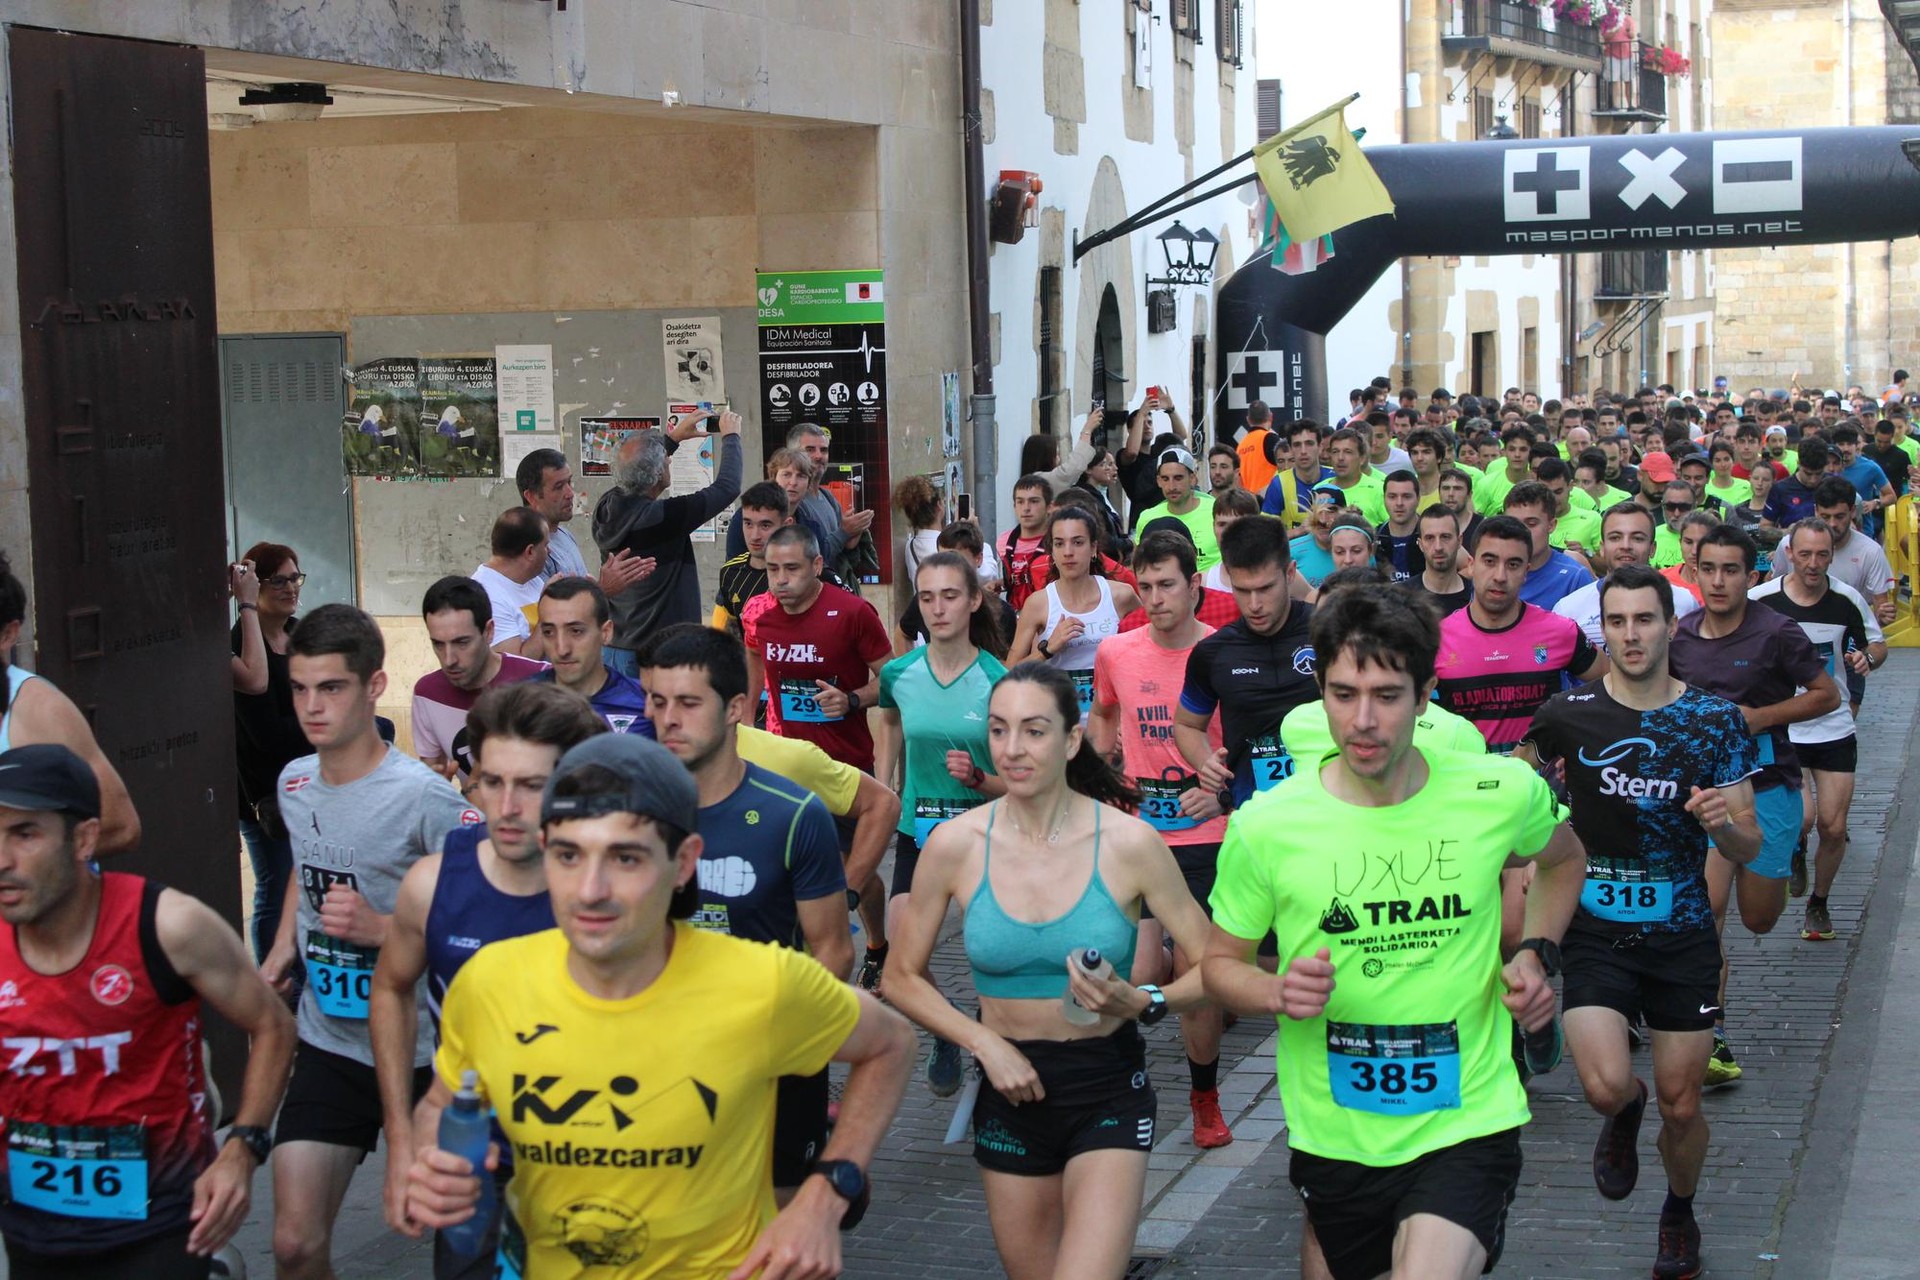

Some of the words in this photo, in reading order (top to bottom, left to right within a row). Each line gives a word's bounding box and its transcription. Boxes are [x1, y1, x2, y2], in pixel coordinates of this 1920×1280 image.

[1505, 219, 1804, 242] maspormenos.net
[758, 308, 785, 317] DESA
[665, 323, 702, 331] Osakidetza
[766, 330, 790, 340] IDM
[793, 328, 832, 339] Medical
[388, 365, 415, 373] EUSKAL
[766, 362, 834, 370] DESFIBRILADOREA
[766, 370, 820, 378] DESFIBRILADOR
[389, 381, 416, 389] AZOKA
[427, 373, 455, 381] LIBURU
[1291, 352, 1303, 421] os.net
[1137, 705, 1172, 721] XVIII.
[1598, 766, 1678, 800] Stern
[1334, 839, 1462, 898] UXUE
[1592, 866, 1614, 875] TRAIL
[1596, 883, 1657, 908] 318
[1362, 893, 1472, 926] TRAIL
[1340, 936, 1378, 947] MENDI
[1380, 927, 1461, 943] LASTERKETA
[1363, 940, 1438, 954] SOLIDARIOA
[318, 967, 371, 1001] 310
[1339, 1036, 1372, 1048] TRAIL
[2, 1029, 133, 1078] ZTT
[1350, 1061, 1438, 1095] 385
[1379, 1097, 1408, 1105] MIKEL
[515, 1140, 705, 1169] valdezcaray
[31, 1160, 123, 1197] 216
